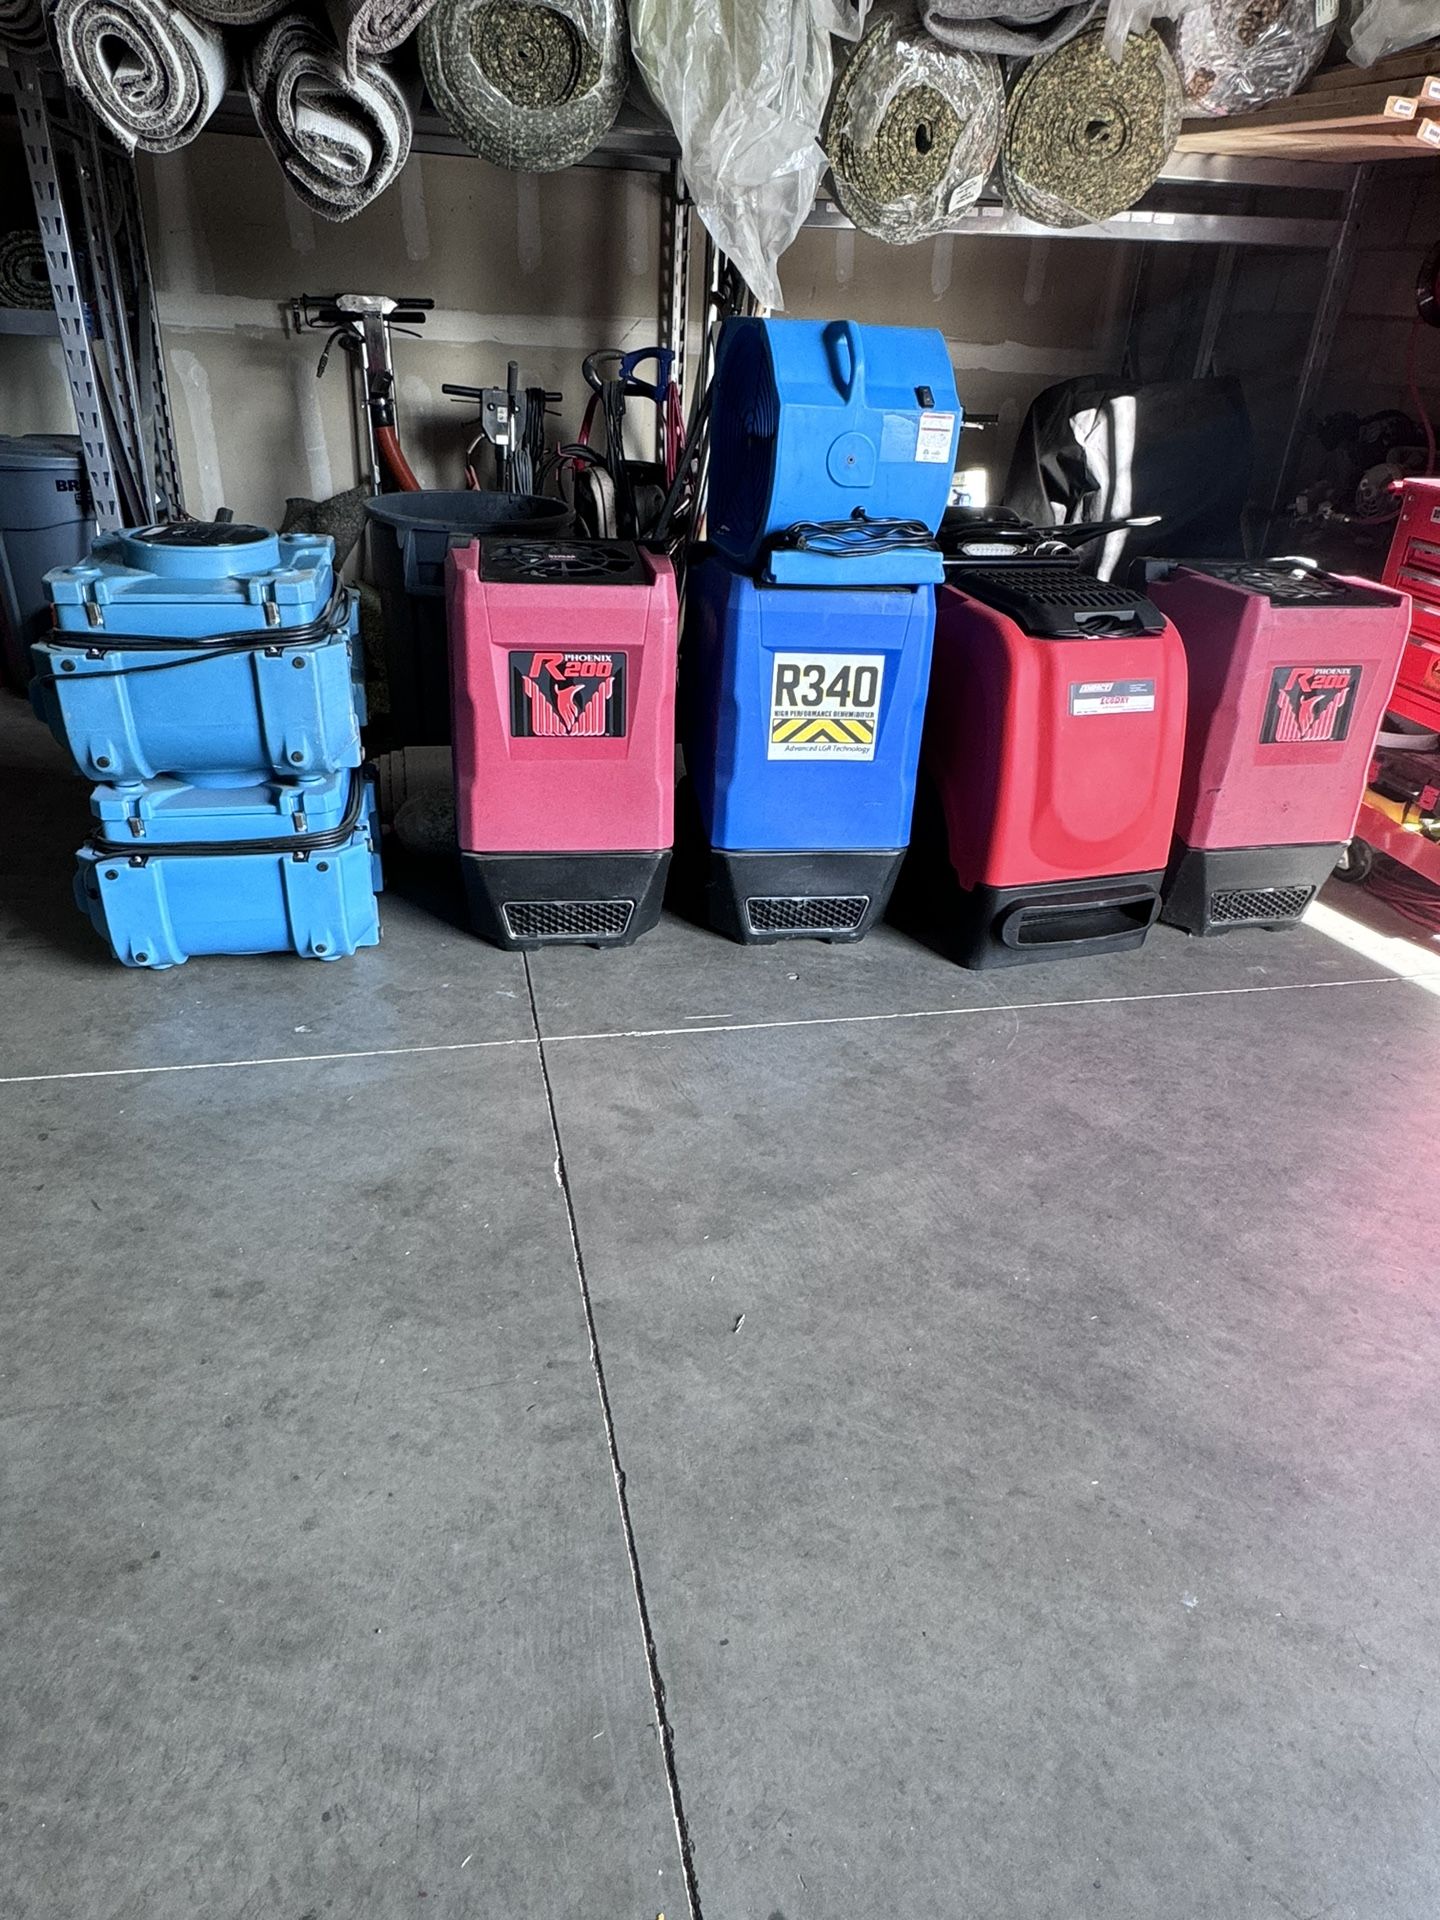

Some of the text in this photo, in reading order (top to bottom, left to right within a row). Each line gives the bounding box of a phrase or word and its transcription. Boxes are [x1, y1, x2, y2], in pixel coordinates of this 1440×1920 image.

[564, 654, 612, 662] PHOENIX
[1314, 667, 1352, 675] PHOENIX
[774, 663, 879, 708] R340
[790, 710, 832, 718] PERFORMANCE
[833, 745, 871, 754] Technology
